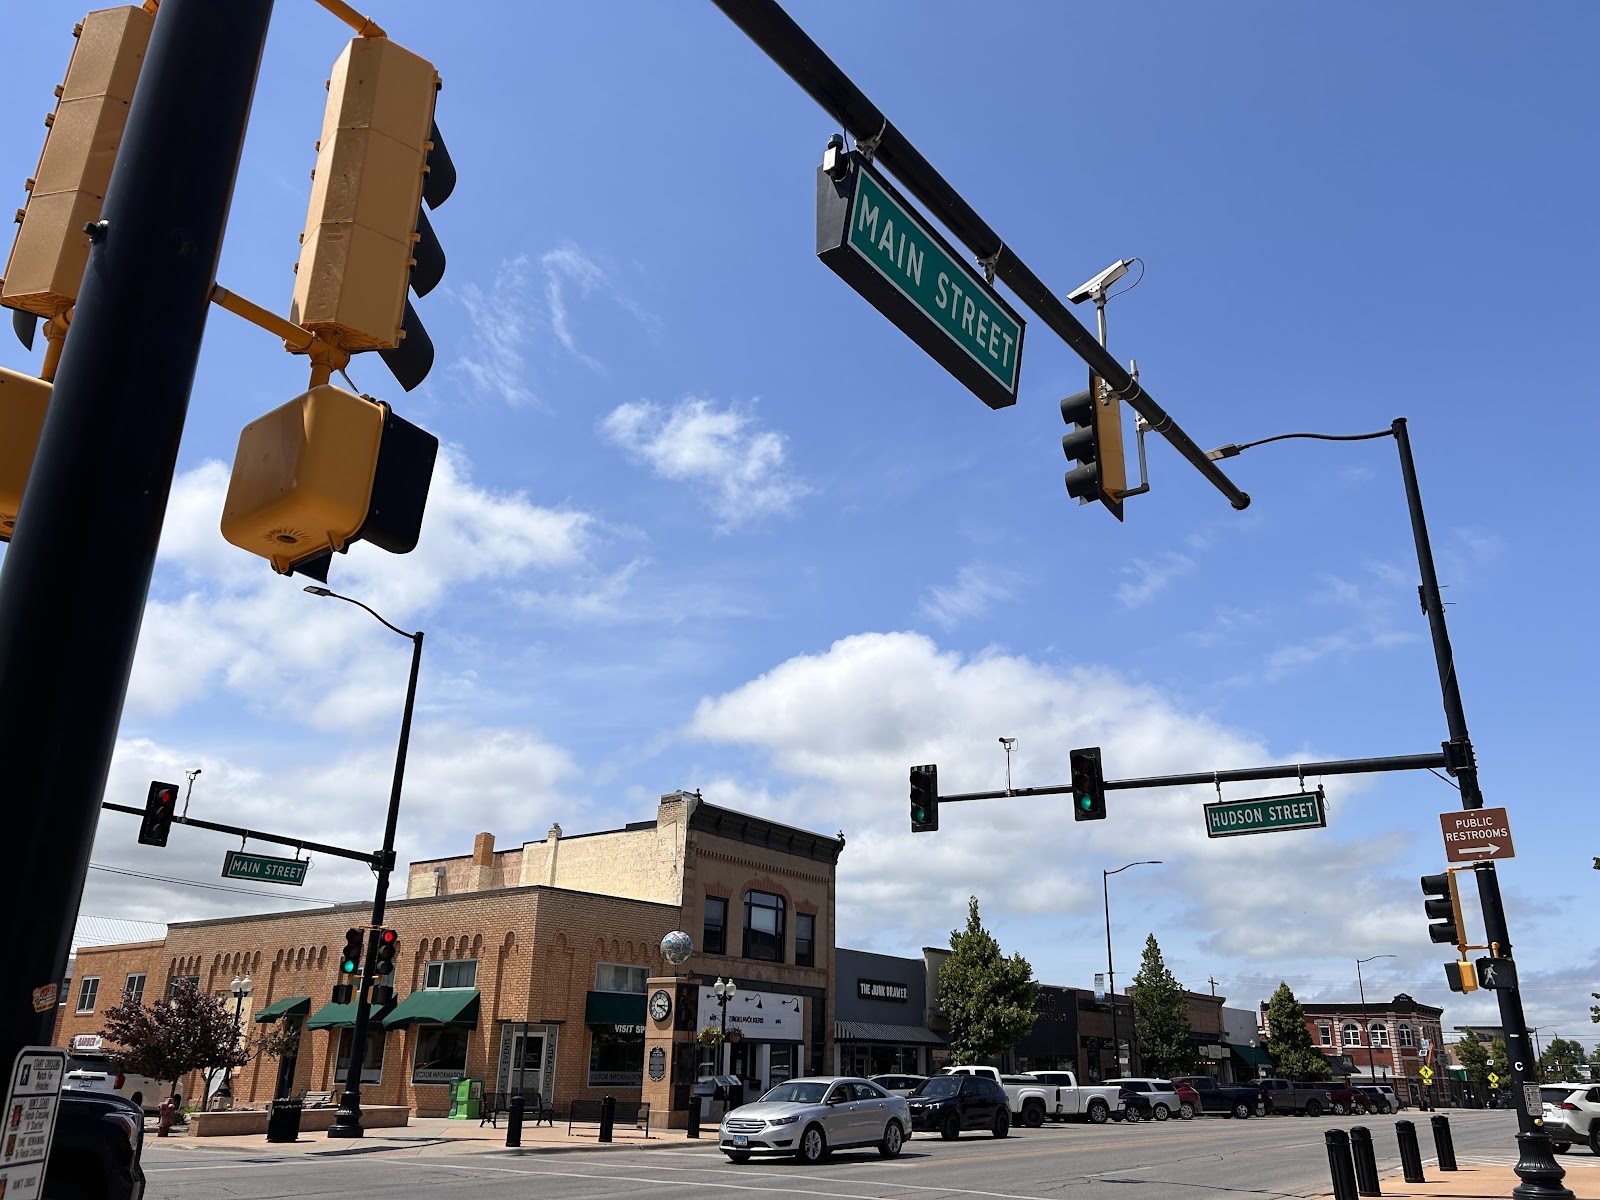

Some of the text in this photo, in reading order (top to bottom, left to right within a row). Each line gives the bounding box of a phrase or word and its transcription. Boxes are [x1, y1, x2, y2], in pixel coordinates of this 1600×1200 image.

[858, 193, 1013, 368] MAIN STREET
[1211, 802, 1314, 827] HUDSON STREET
[1455, 817, 1493, 829] PUBLIC
[1445, 828, 1508, 842] RESTROOMS
[232, 860, 303, 879] MAIN STREET
[860, 983, 908, 999] THE JUNK DRAWER
[614, 1024, 635, 1034] VISIT
[502, 1038, 511, 1064] EVENTS
[545, 1043, 554, 1093] ATTRACTIONS
[1514, 1061, 1524, 1072] C
